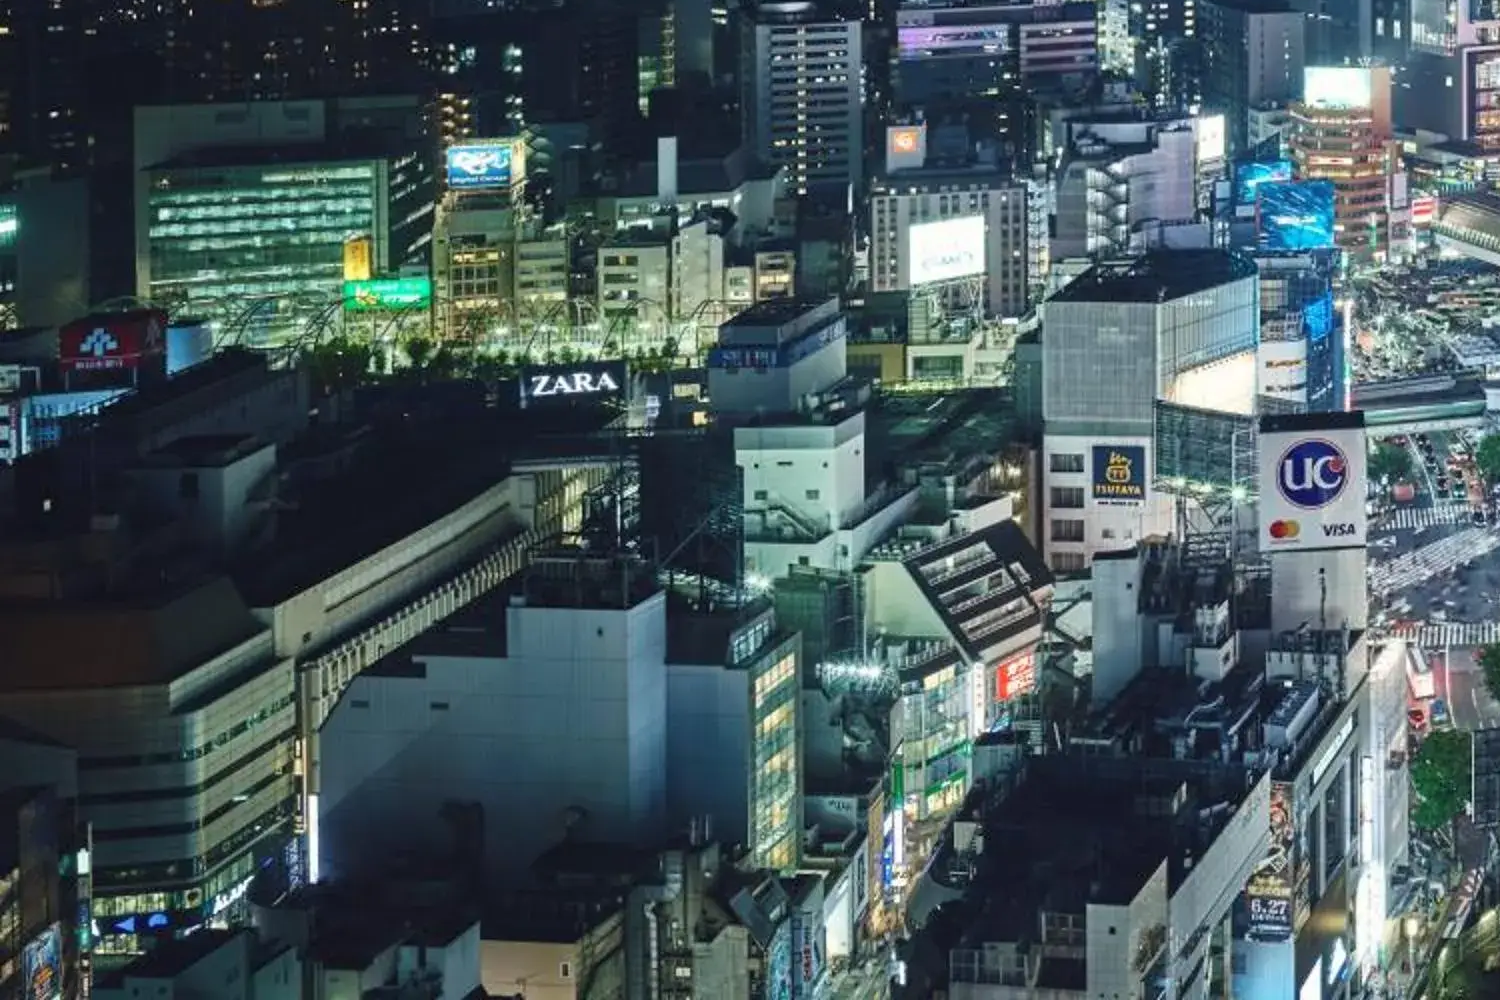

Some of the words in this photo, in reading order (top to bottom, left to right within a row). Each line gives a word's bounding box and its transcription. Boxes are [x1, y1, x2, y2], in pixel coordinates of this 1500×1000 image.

[531, 372, 619, 396] ZARA
[1096, 484, 1141, 495] TSUTAYA
[1323, 523, 1356, 536] VISA
